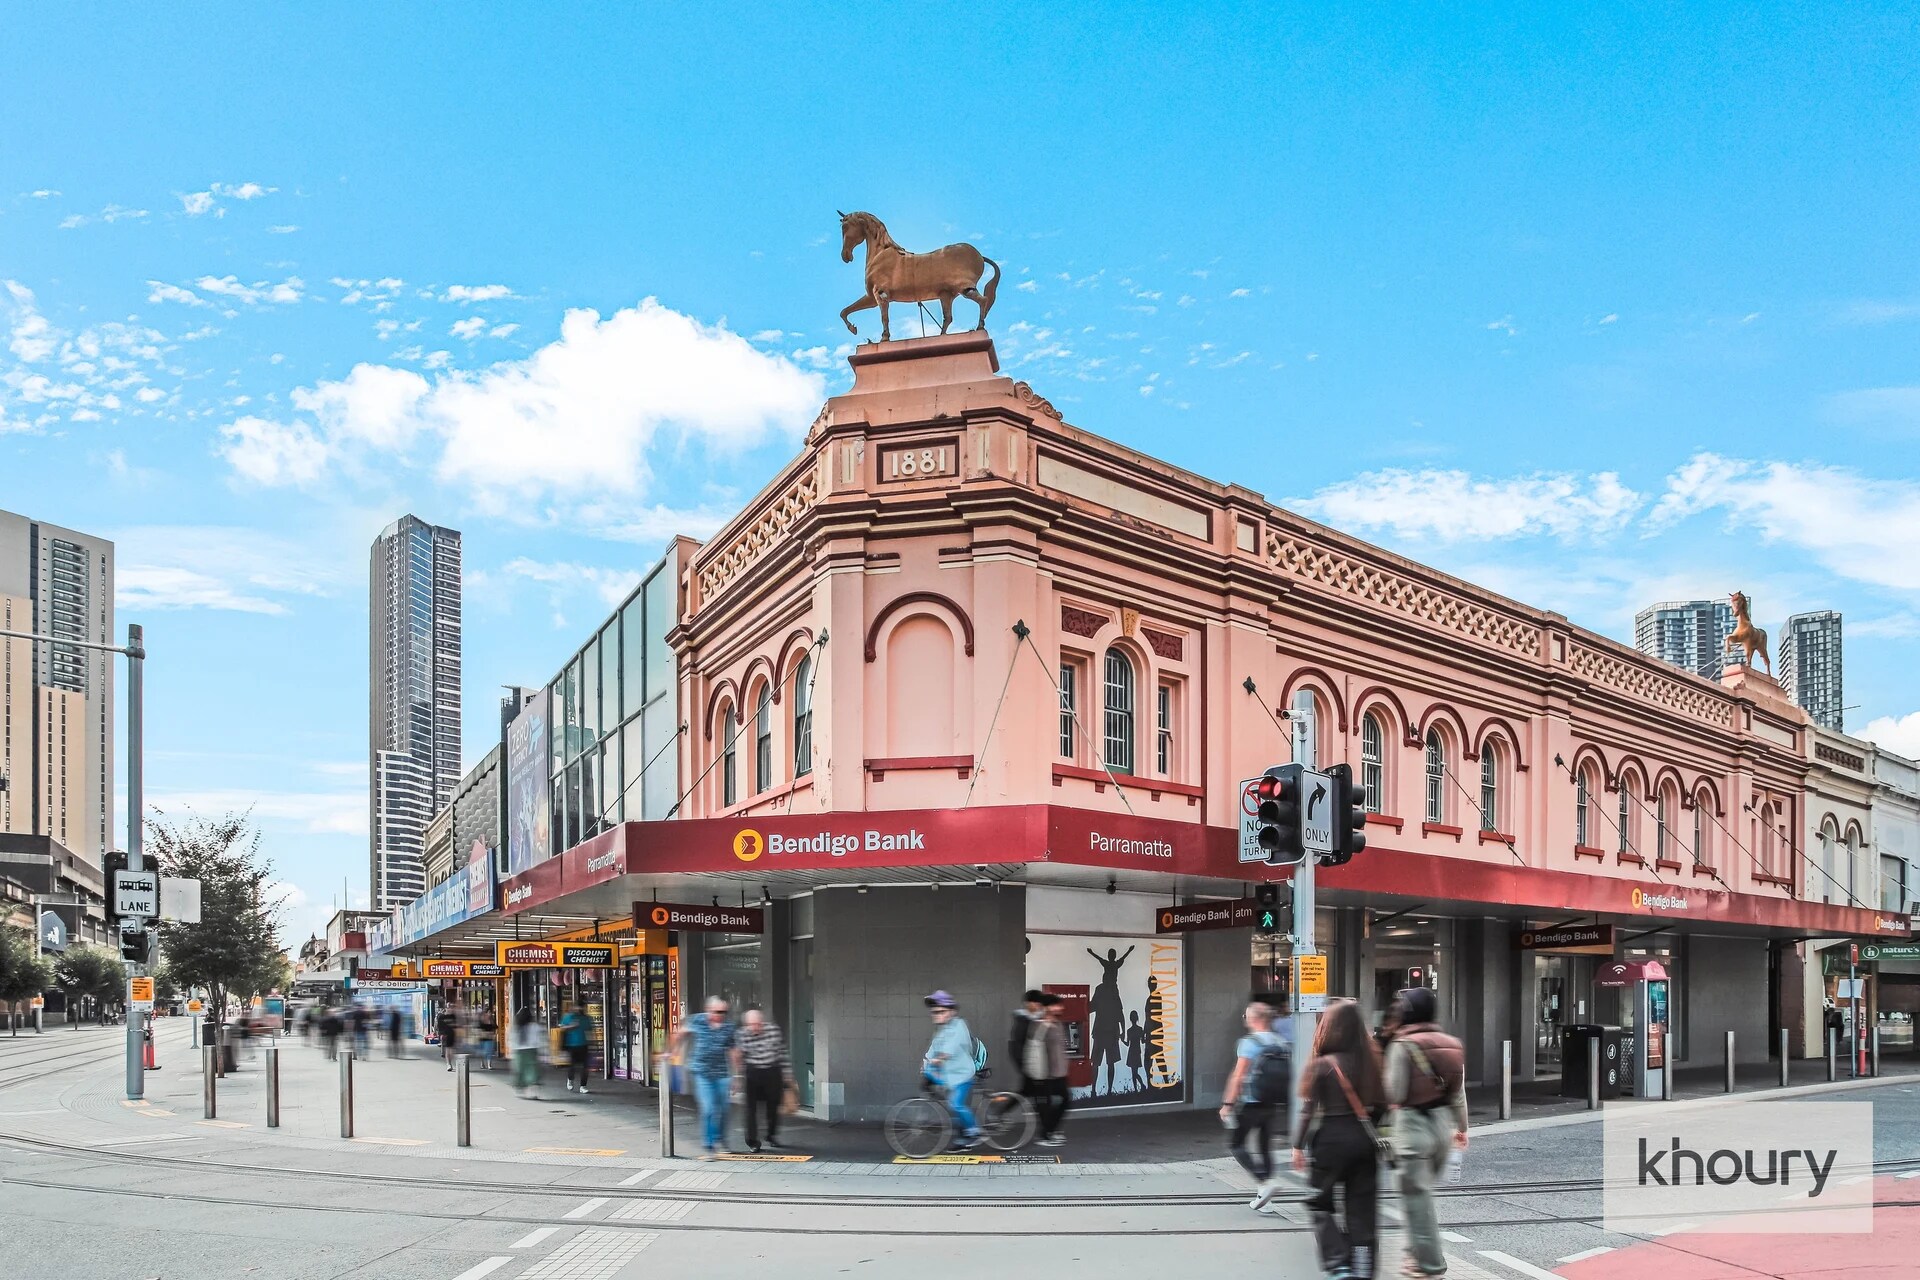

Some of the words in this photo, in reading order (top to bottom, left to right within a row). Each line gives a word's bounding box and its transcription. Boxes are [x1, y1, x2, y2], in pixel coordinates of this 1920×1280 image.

[892, 448, 946, 476] 1881
[1246, 820, 1263, 832] NO
[1244, 836, 1259, 845] LEF
[1306, 828, 1330, 843] ONLY
[768, 832, 860, 857] Bendigo
[864, 829, 925, 851] Bank
[1090, 832, 1172, 857] Parramatta
[1243, 848, 1266, 857] TURN
[587, 849, 616, 873] Parramatta
[120, 901, 150, 912] LANE
[1642, 892, 1670, 909] Bendigo
[1671, 896, 1688, 910] Bank
[670, 911, 719, 926] Bendigo
[720, 914, 750, 926] Bank
[1174, 912, 1206, 924] Bendigo
[1207, 909, 1230, 920] Bank
[1235, 908, 1252, 918] atm
[1535, 933, 1572, 944] Bendigo
[1574, 931, 1599, 941] Bank
[508, 949, 555, 959] CHEMIST
[567, 949, 609, 957] DISCOUNT
[1882, 946, 1920, 954] nature's
[570, 956, 605, 964] CHEMIST
[671, 1001, 677, 1012] 7
[1150, 943, 1178, 1089] COMMUNITY
